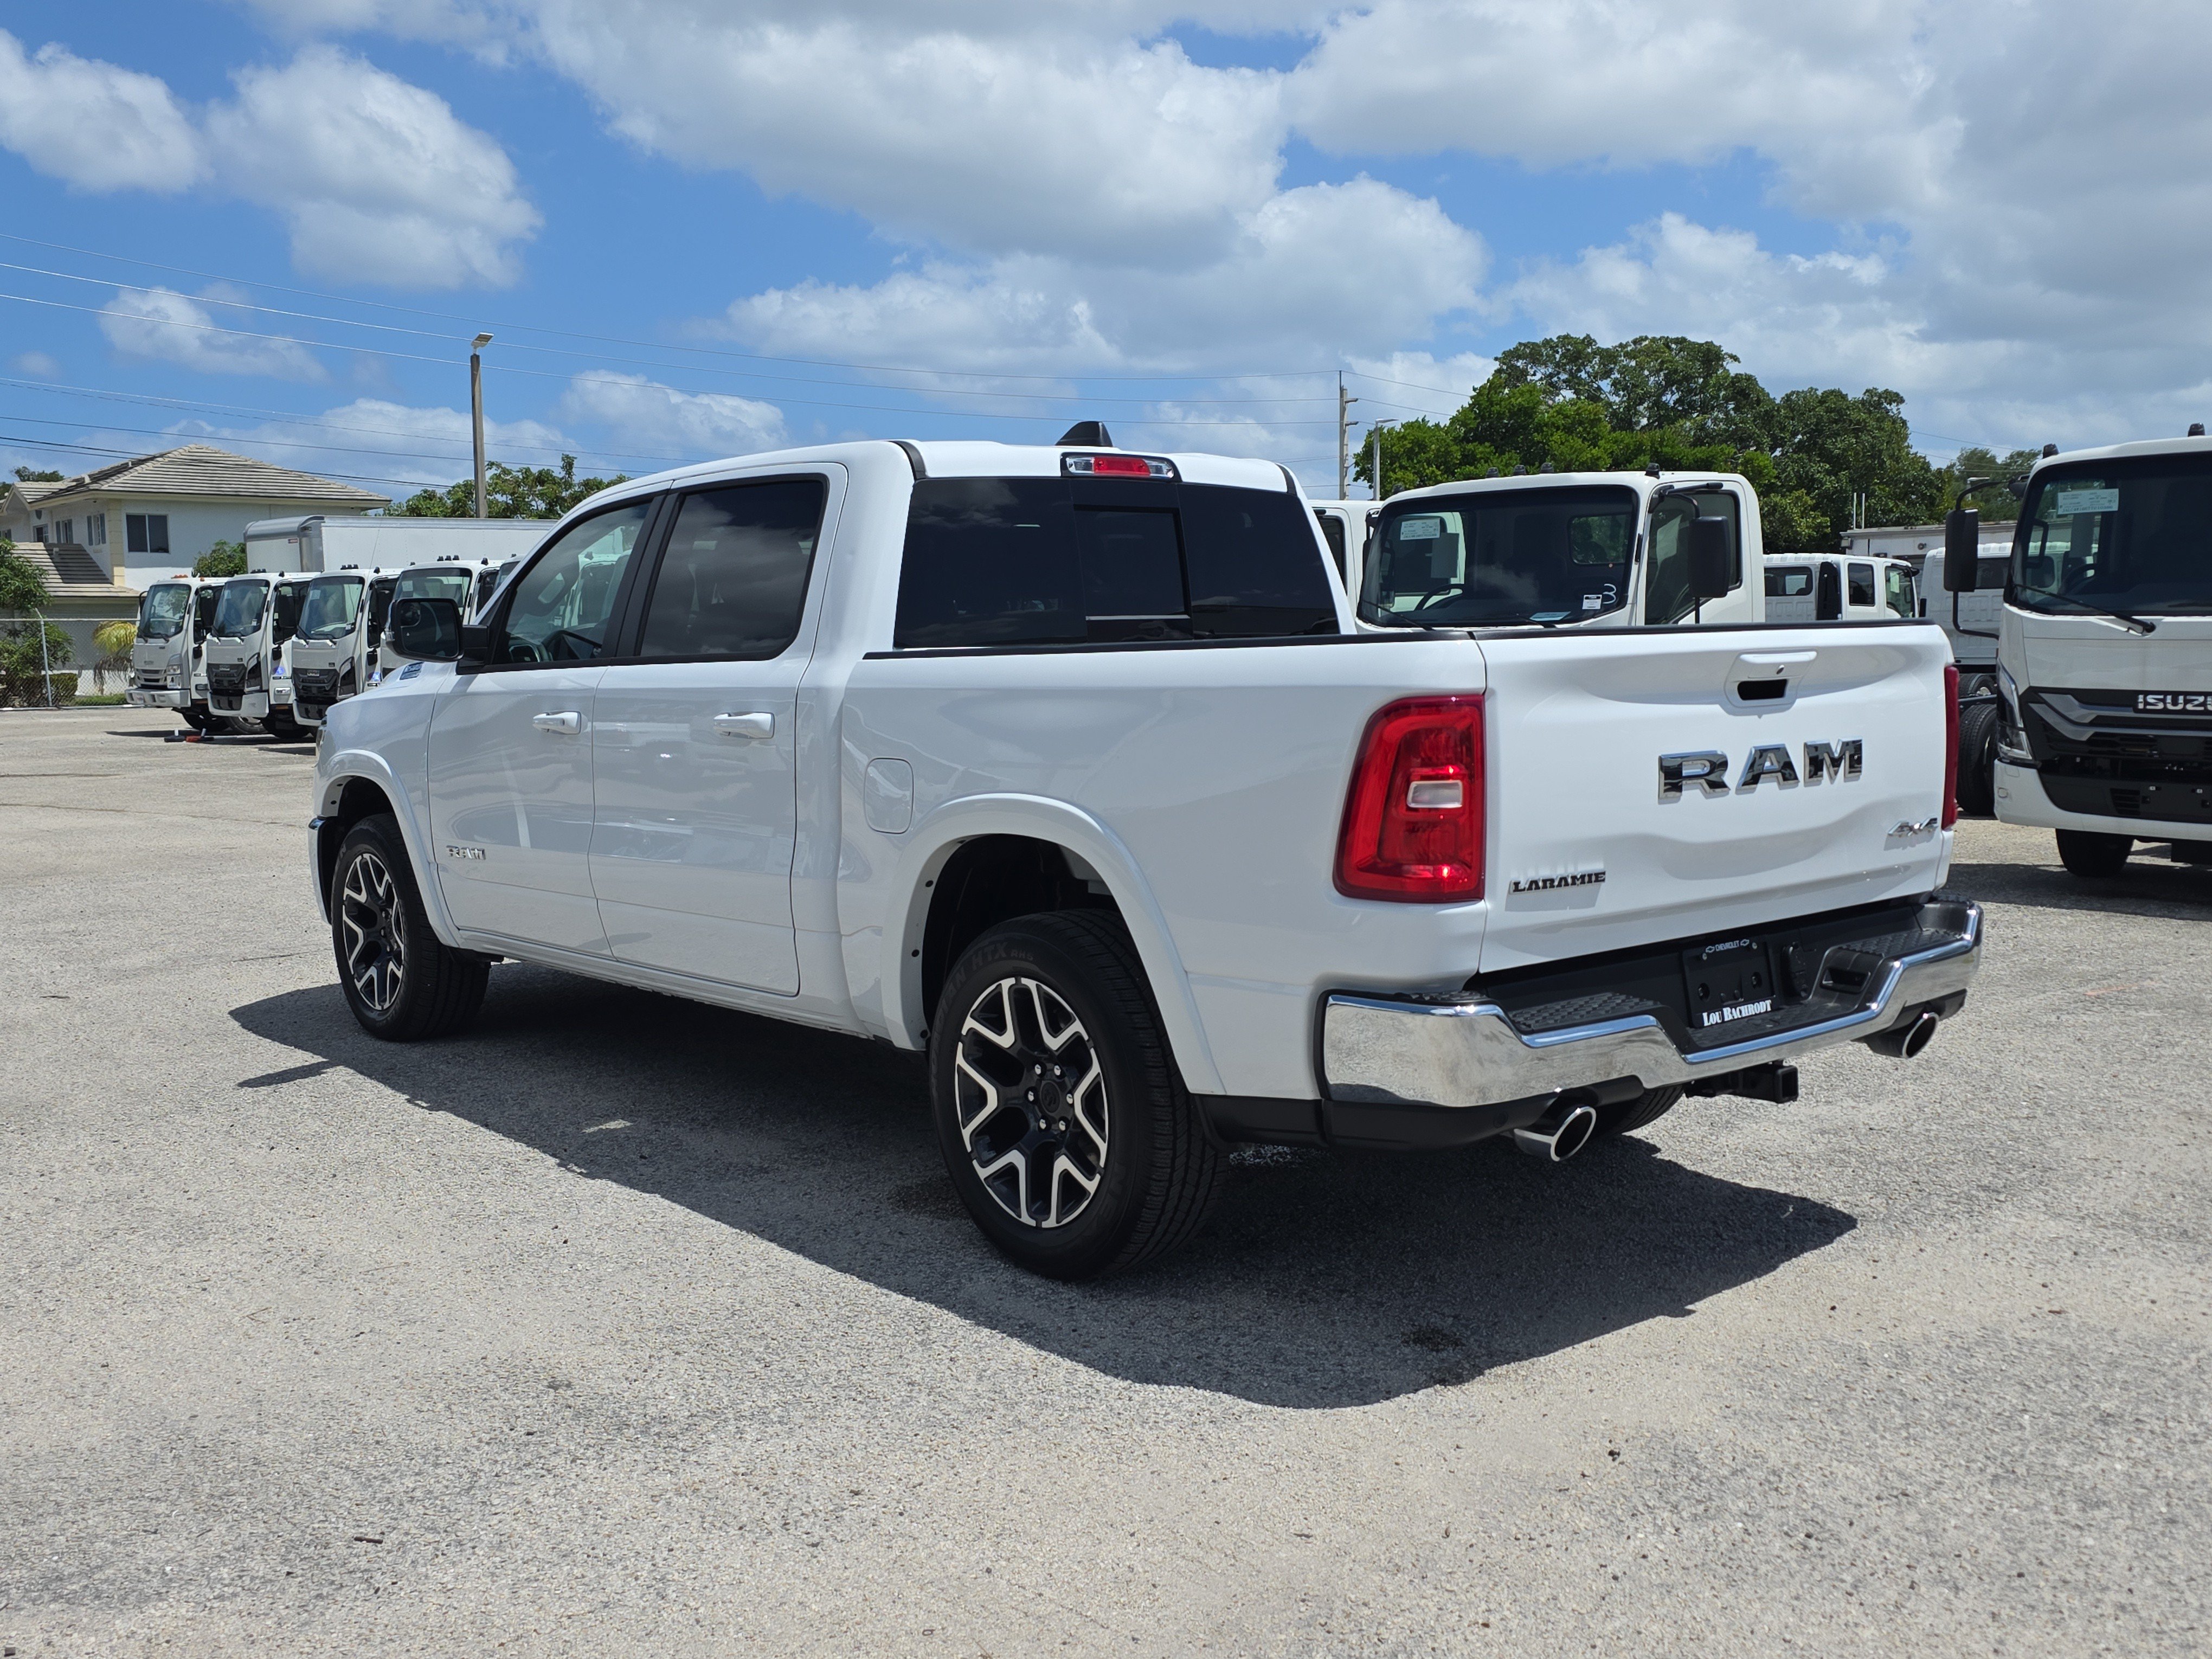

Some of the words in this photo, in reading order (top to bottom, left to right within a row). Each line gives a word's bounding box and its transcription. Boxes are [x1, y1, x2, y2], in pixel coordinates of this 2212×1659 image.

[1658, 736, 1863, 800] RAM
[446, 845, 486, 860] RAM
[1509, 870, 1606, 894] LARAMIE
[1702, 1011, 1722, 1026] LOU
[1722, 999, 1772, 1021] BACHRODT
